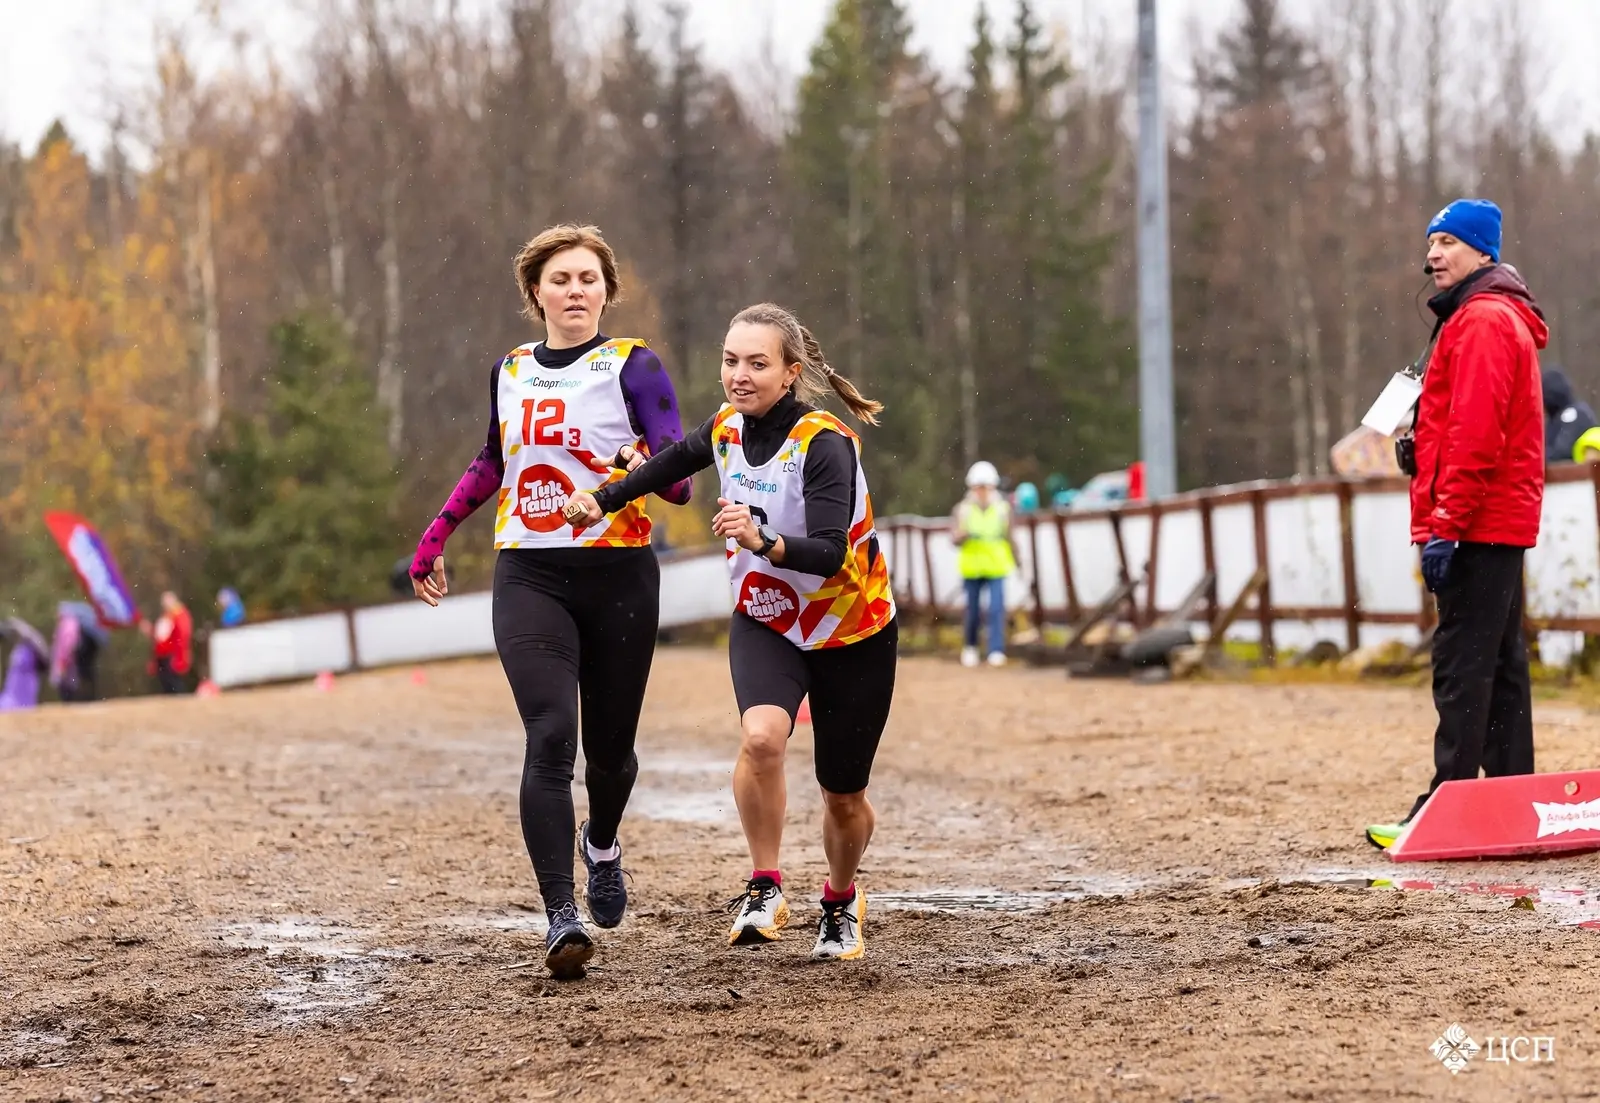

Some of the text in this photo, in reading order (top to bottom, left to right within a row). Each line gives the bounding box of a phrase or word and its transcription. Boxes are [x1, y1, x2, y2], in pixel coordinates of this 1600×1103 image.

[590, 361, 612, 372] ЦСП
[532, 376, 582, 390] СпортБюро
[521, 398, 581, 448] 12 3
[782, 461, 798, 474] ЦС
[523, 480, 565, 500] Тик
[566, 505, 577, 516] 12
[748, 585, 785, 606] Тик
